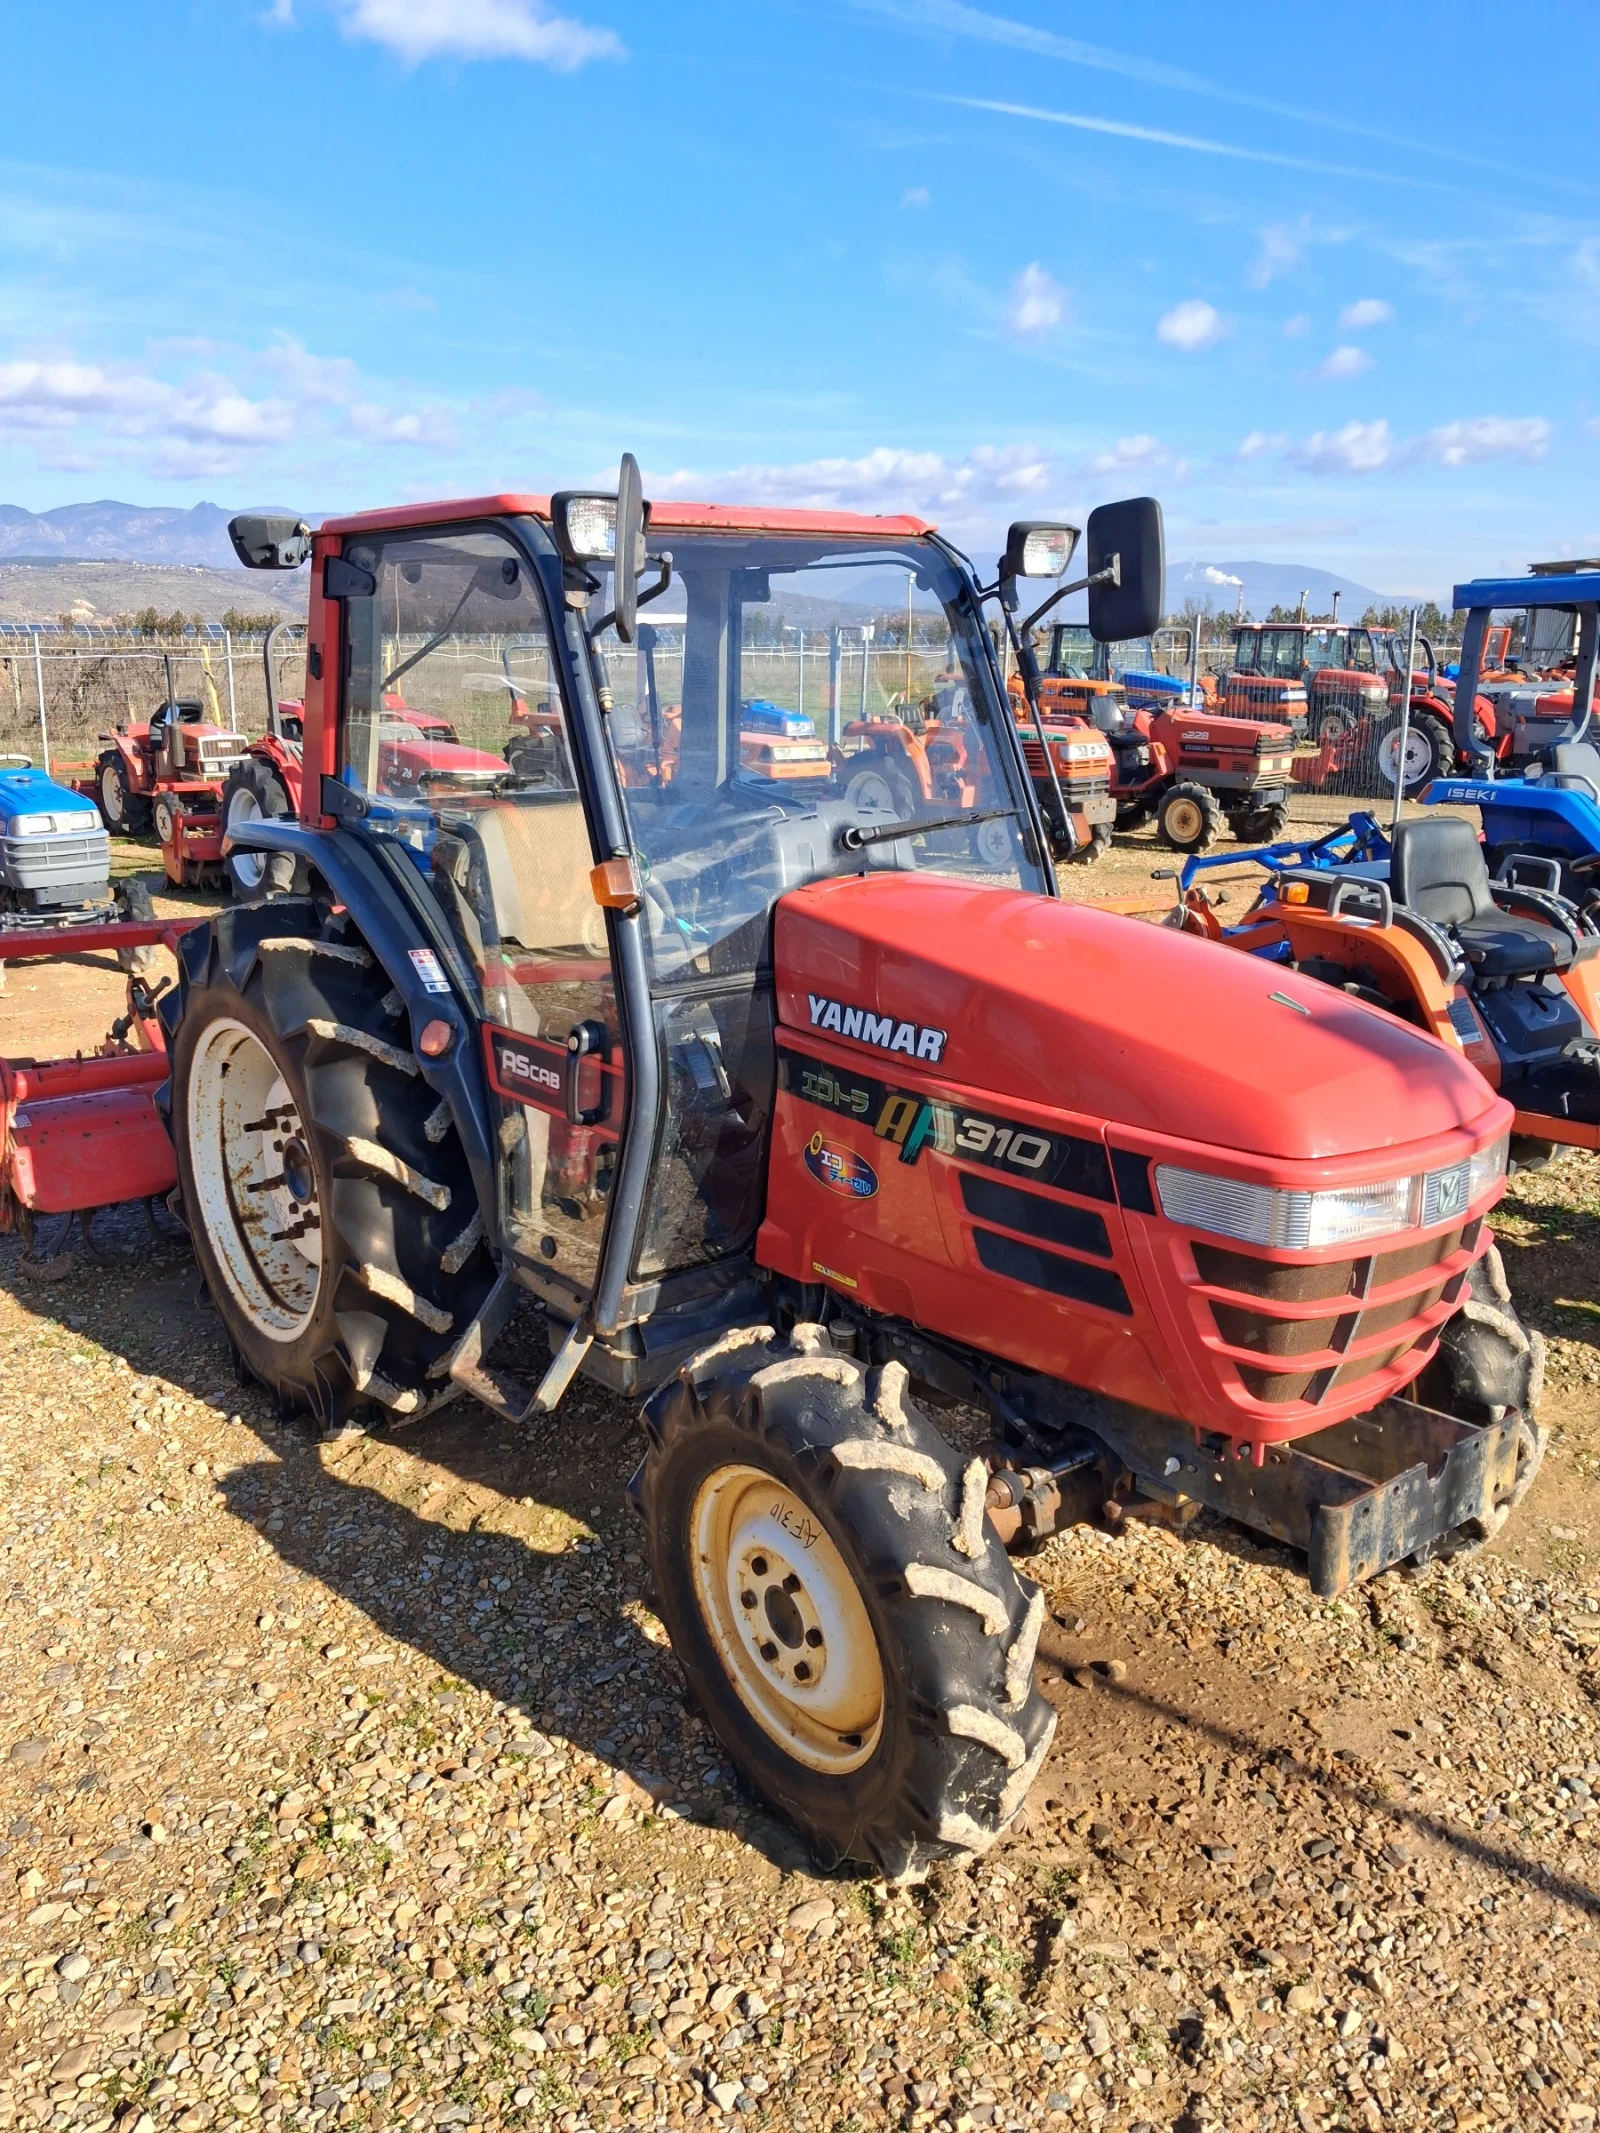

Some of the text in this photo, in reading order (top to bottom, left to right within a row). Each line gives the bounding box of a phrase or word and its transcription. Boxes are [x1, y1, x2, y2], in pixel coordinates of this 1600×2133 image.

[1448, 788, 1497, 800] ISEKI
[808, 994, 946, 1062] YANMAR
[802, 1071, 869, 1113] エコトラ
[821, 1149, 843, 1171] エコ
